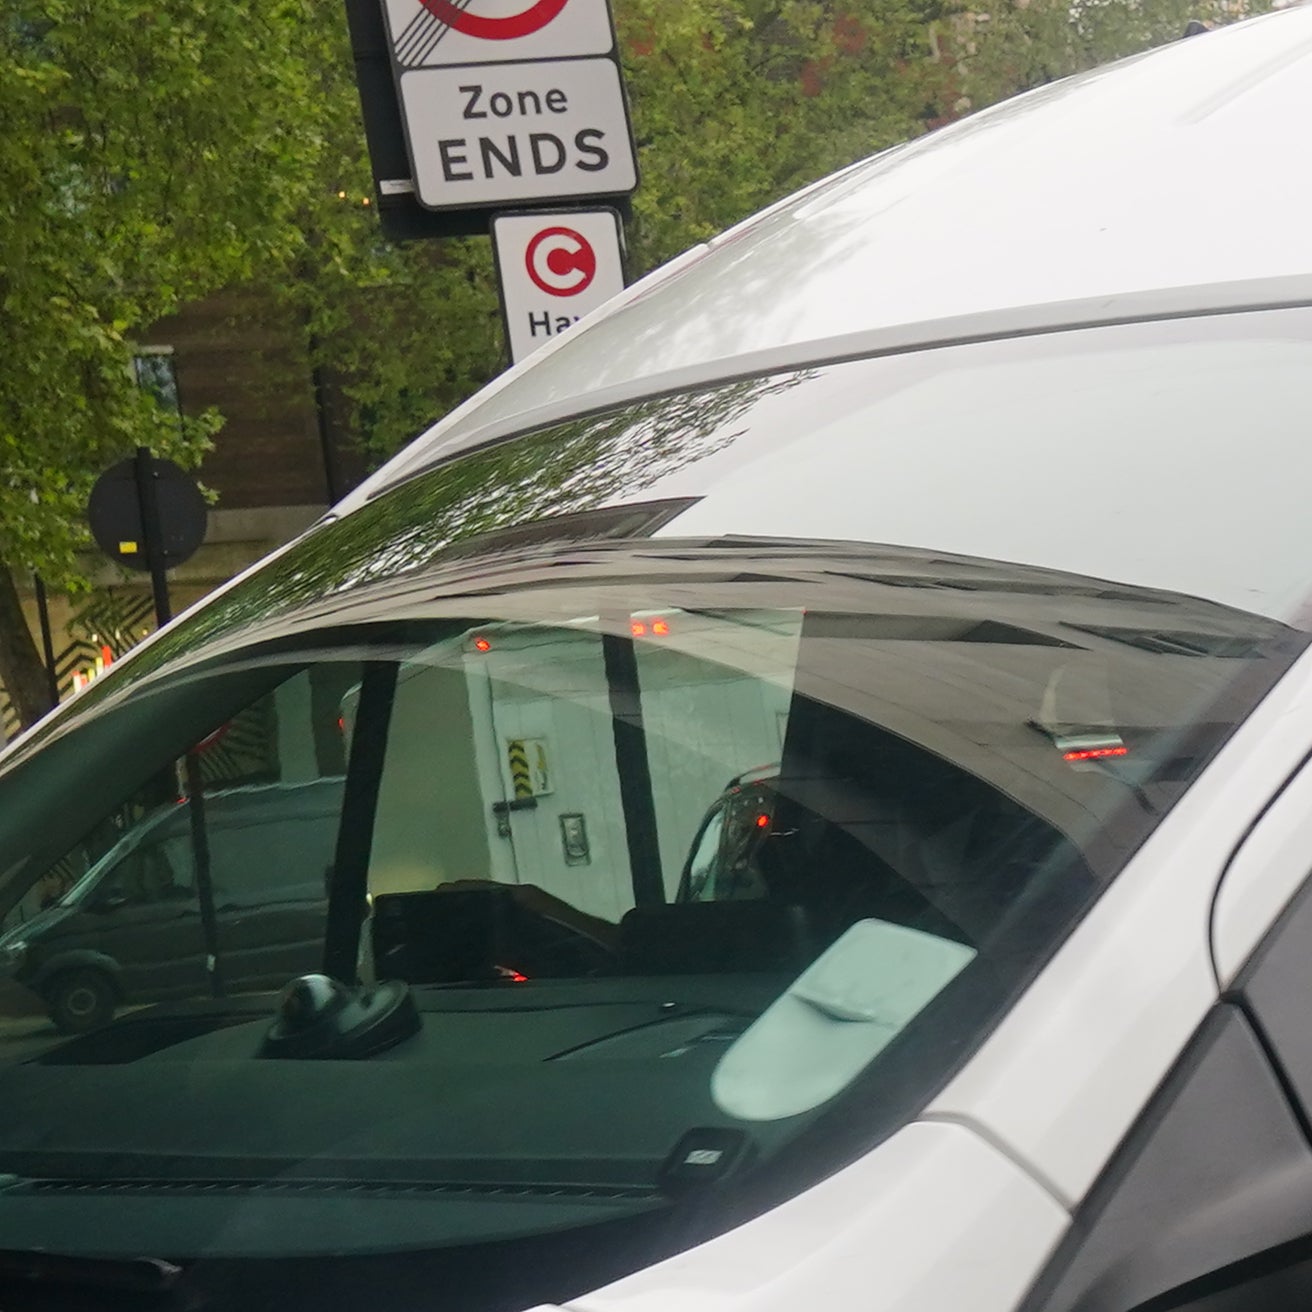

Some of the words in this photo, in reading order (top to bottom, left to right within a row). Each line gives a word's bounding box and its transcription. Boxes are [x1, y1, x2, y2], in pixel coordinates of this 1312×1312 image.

[458, 85, 568, 120] Zone
[438, 128, 610, 182] ENDS
[528, 310, 581, 336] Ha
